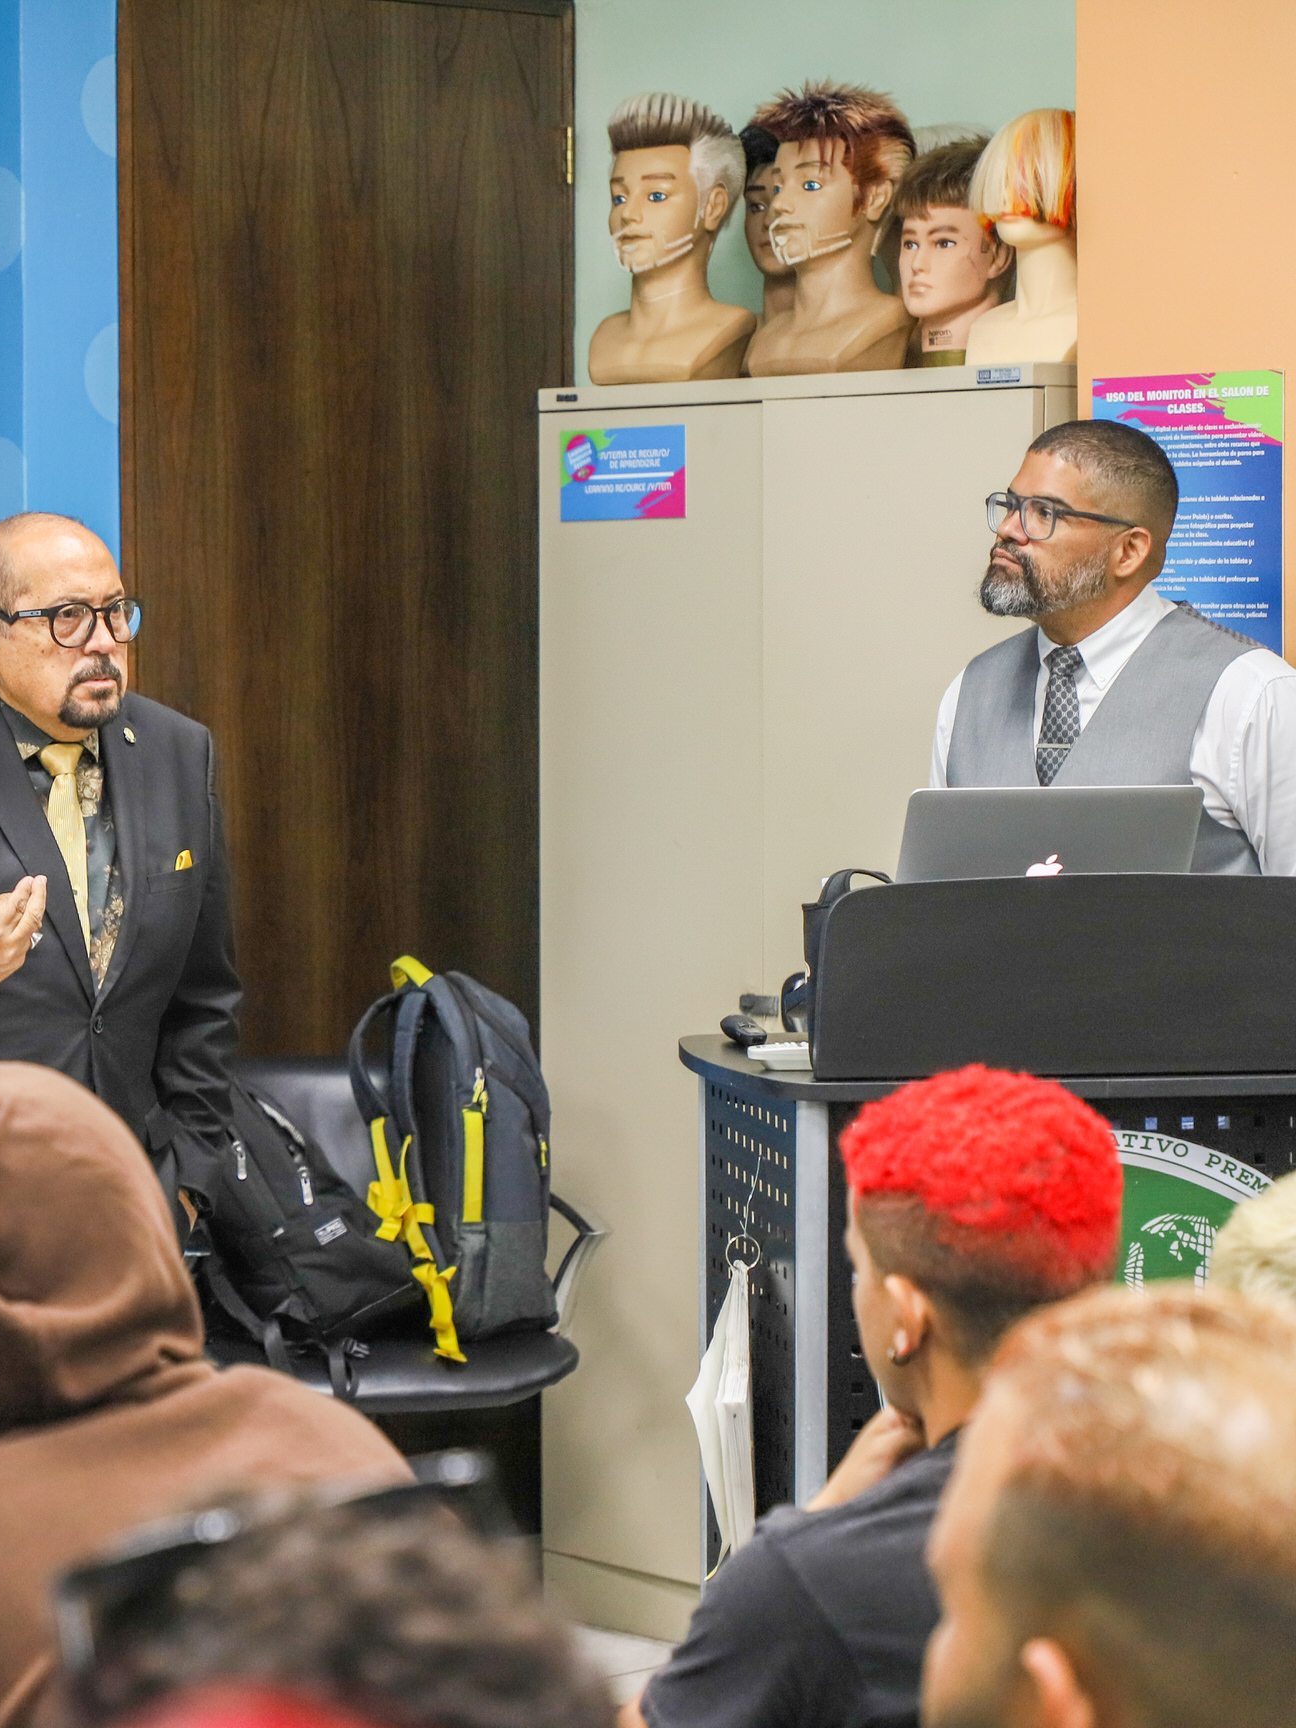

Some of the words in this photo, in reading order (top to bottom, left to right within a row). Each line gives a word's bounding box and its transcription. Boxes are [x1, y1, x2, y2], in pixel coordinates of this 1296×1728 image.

[1106, 392, 1125, 402] USO
[1127, 391, 1145, 402] DEL
[1147, 389, 1191, 401] MONITOR
[1193, 388, 1206, 399] EN
[1207, 387, 1219, 398] EL
[1256, 385, 1269, 396] DE
[1167, 402, 1206, 414] CLASES:
[629, 449, 637, 458] DE
[609, 460, 618, 469] DE
[1204, 1153, 1270, 1194] PREM
